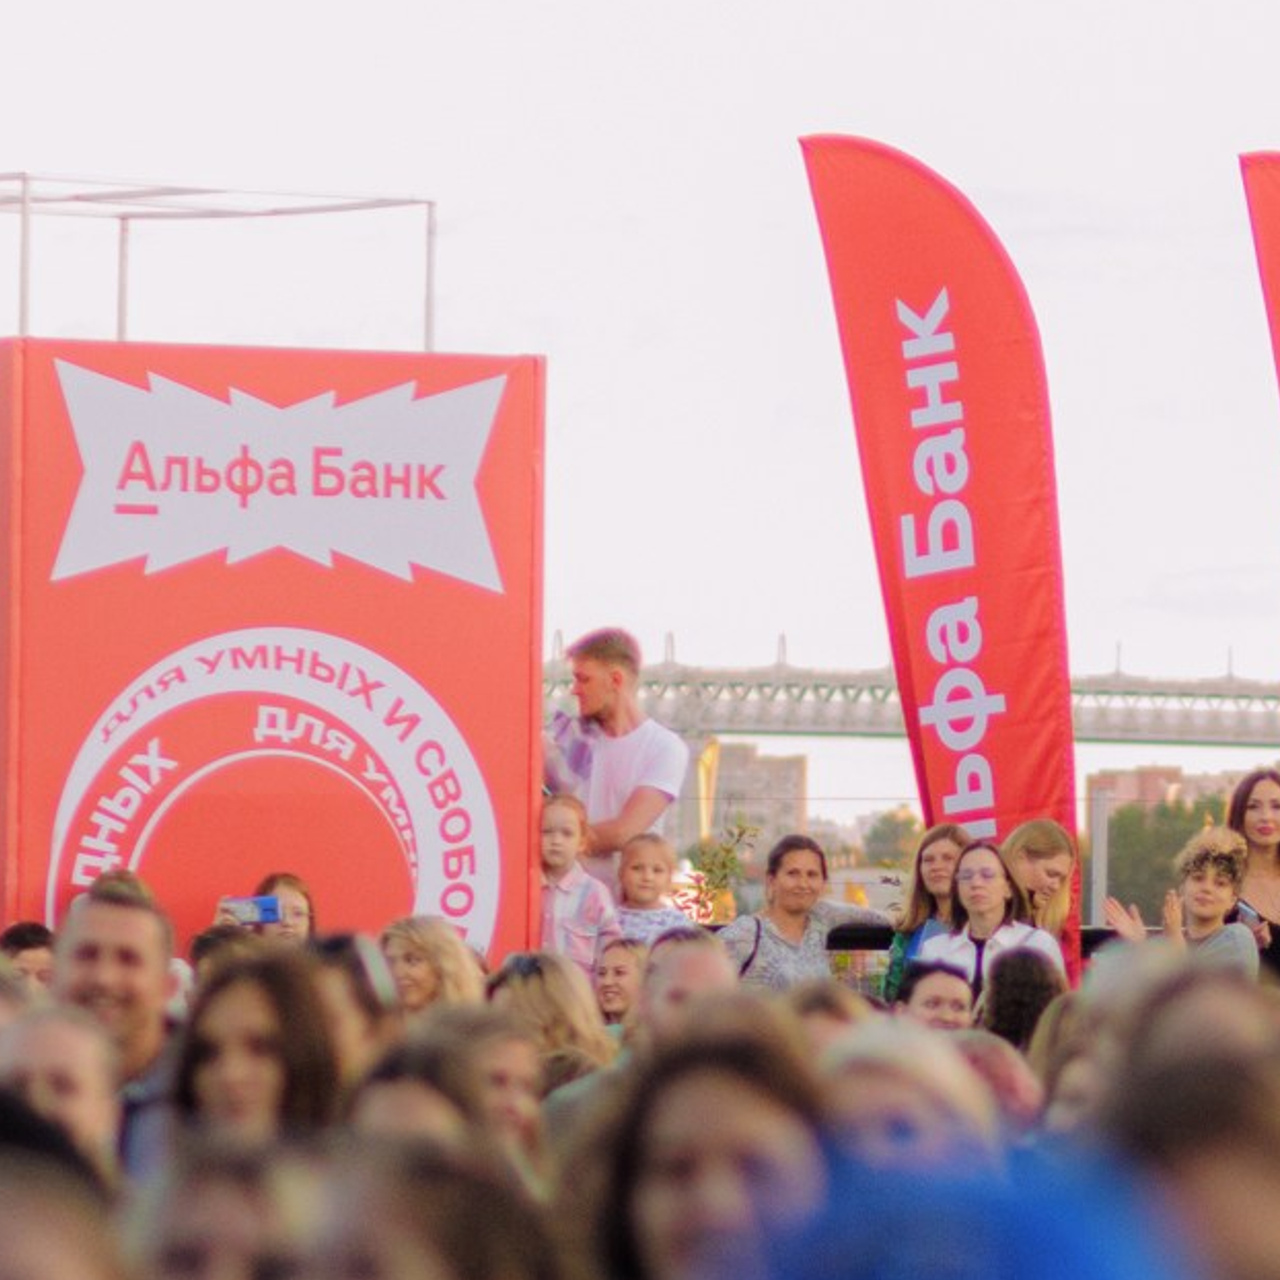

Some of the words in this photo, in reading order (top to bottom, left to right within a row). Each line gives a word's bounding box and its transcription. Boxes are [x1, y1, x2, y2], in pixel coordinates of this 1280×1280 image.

[115, 439, 297, 510] Альфа
[311, 445, 448, 500] Банк
[895, 286, 976, 579] Банк
[70, 737, 178, 900] ДНЫХ
[254, 705, 357, 762] ДЛЯ
[101, 665, 186, 743] ДЛЯ
[195, 644, 386, 710] УМНЫХ
[381, 697, 421, 743] И
[415, 738, 476, 939] СВОБО
[917, 596, 1006, 839] ьфа
